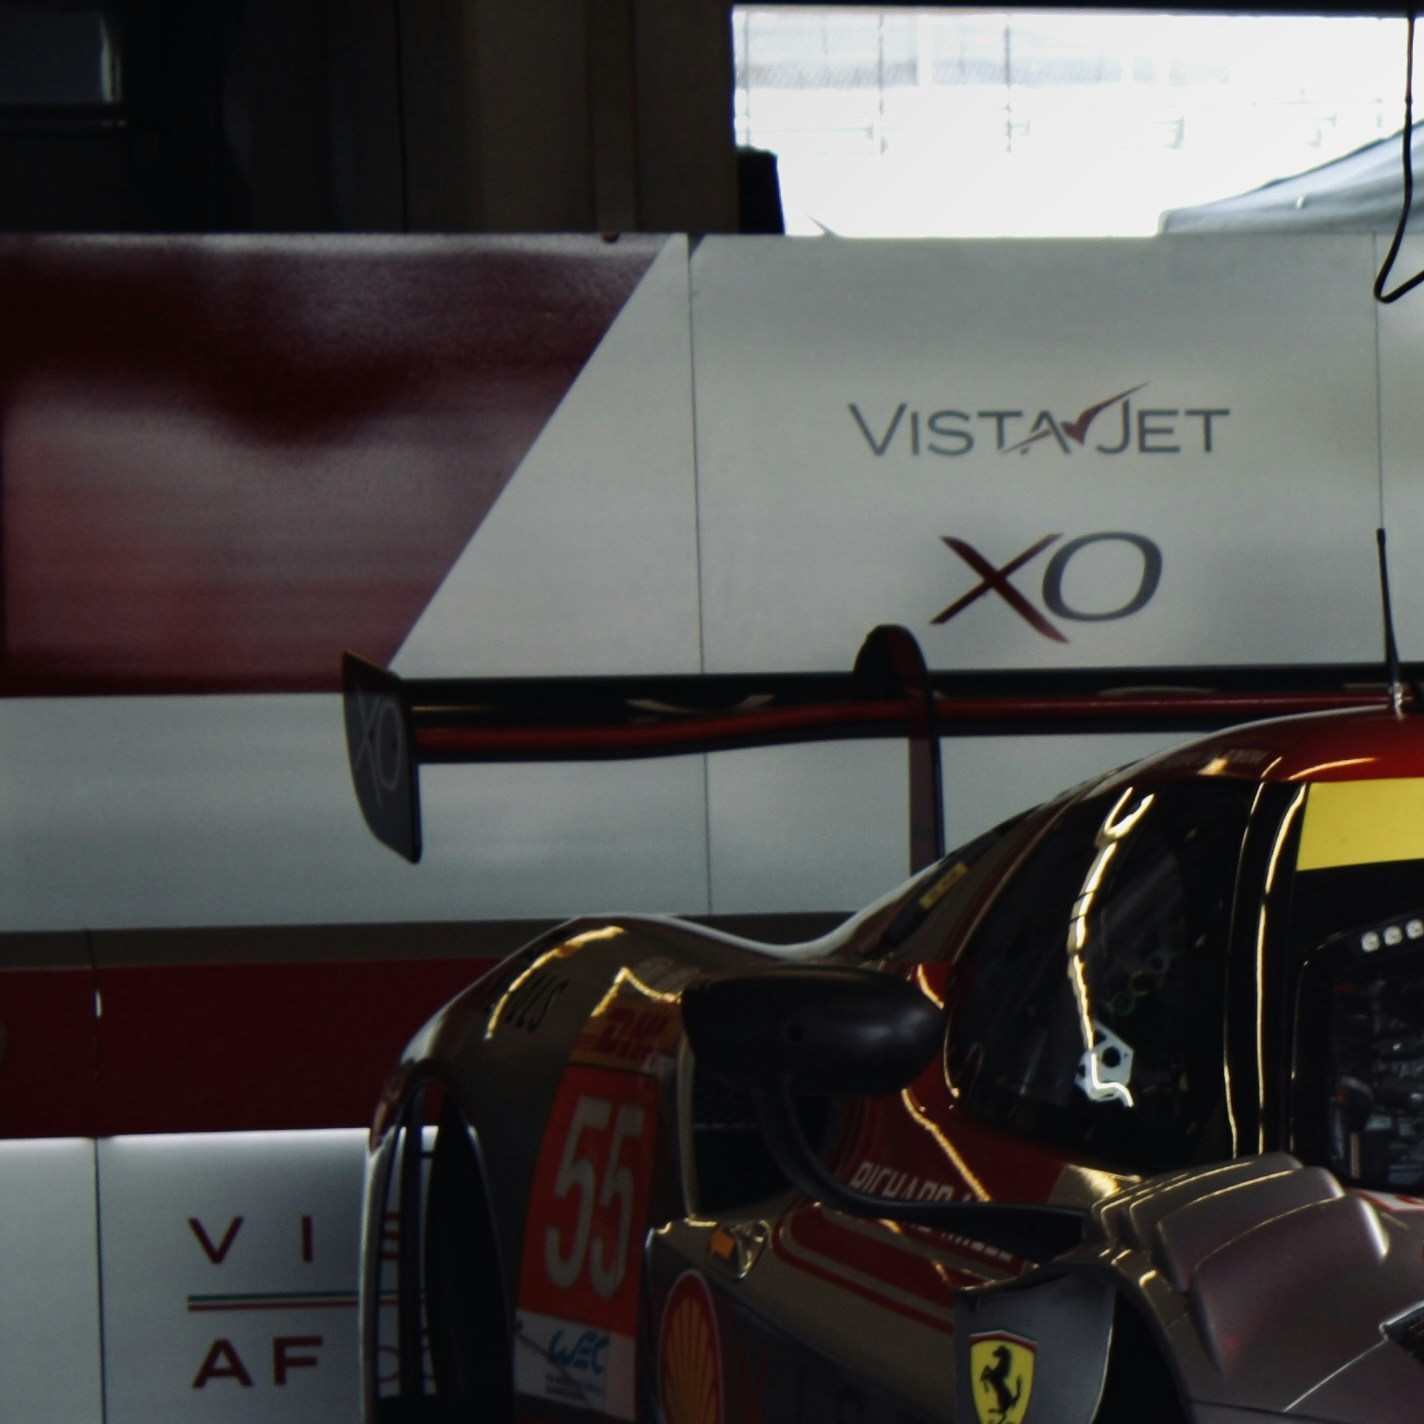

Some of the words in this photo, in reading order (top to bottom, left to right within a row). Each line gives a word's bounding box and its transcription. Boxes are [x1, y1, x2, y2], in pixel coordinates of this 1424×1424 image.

[849, 383, 1230, 457] VISTAJET
[929, 531, 1162, 643] XO
[544, 1095, 645, 1299] 55
[193, 1336, 323, 1388] AF
[549, 1329, 610, 1374] WEC
